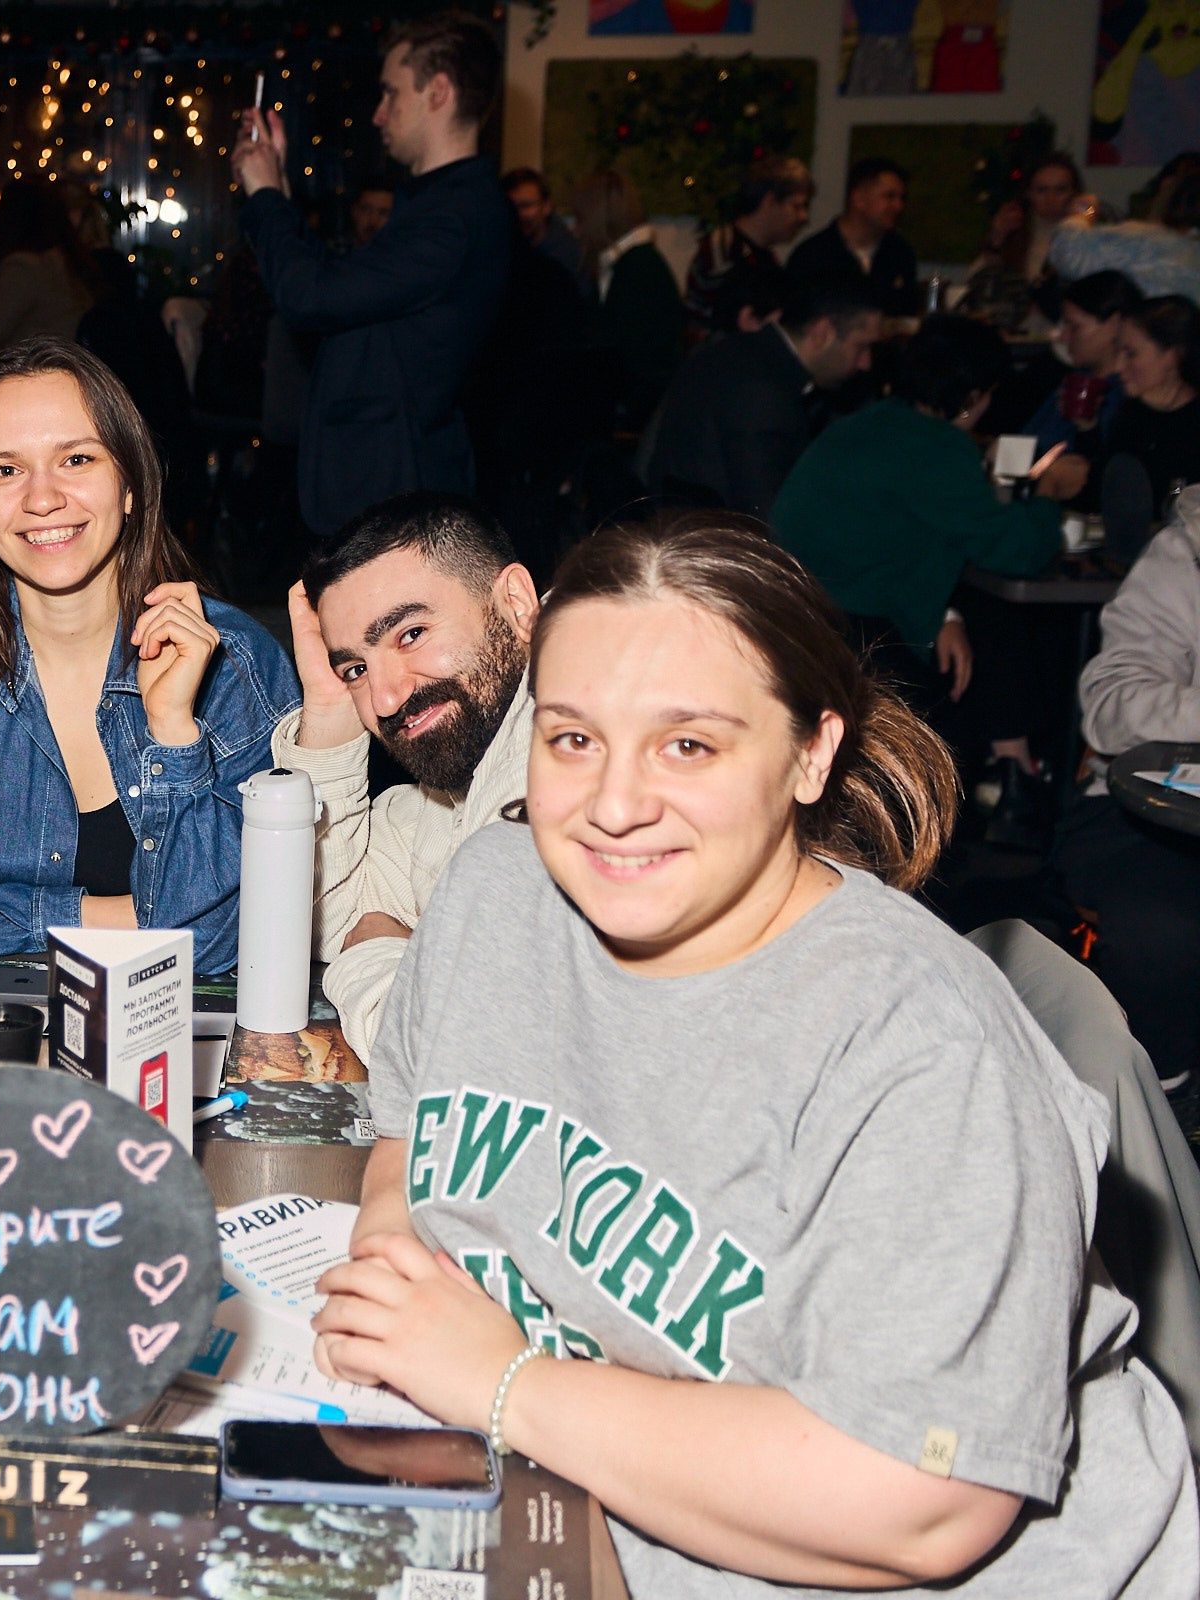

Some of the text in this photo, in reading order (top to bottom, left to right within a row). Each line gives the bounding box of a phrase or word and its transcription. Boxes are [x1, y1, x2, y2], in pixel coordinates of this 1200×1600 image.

[123, 978, 182, 1014] МЫ ЗАПУСТИЛИ
[130, 994, 176, 1023] ПРОГРАММУ
[126, 1006, 179, 1039] ЛОЯЛЬНОСТИ!
[217, 1197, 333, 1242] РАВИЛА
[538, 1115, 766, 1382] YORK
